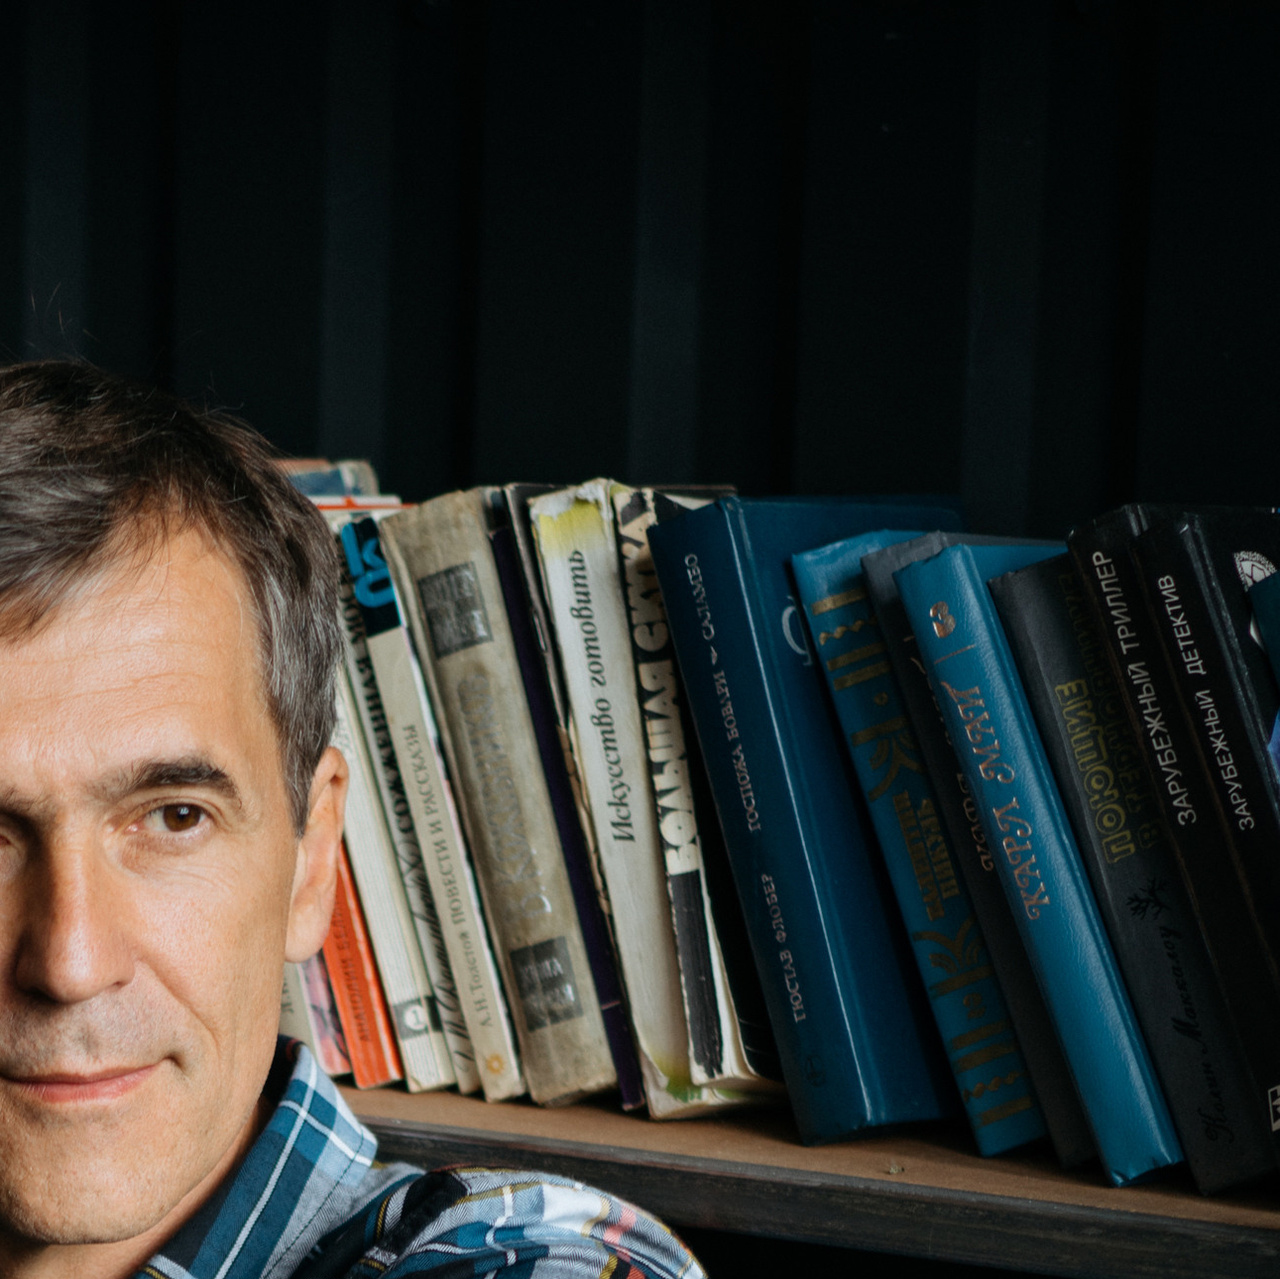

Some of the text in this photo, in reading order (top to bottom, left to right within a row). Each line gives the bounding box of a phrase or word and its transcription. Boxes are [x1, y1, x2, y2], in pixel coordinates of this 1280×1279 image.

[356, 657, 413, 833] СОЖЖЕННАЯ
[402, 724, 440, 816] РАССКАЗЫ
[569, 550, 637, 843] Искусство готовить
[638, 660, 701, 876] БОЛЬШАЯ
[685, 553, 762, 833] ГОСПОЖА БОВАРИ САЛАМБО
[1053, 678, 1138, 866] ПОЮЩИЕ
[1092, 551, 1198, 827] ЗАРУБЕЖНЫЙ ТРИЛЛЕР
[1158, 574, 1256, 832] ЗАРУБЕЖНЫЙ ДЕТЕКТИВ
[435, 838, 466, 925] ПОВЕСТИ
[940, 680, 1050, 920] КАРЛ МАЙ
[761, 873, 807, 1024] ГЮСТАВ ФЛОБЕР
